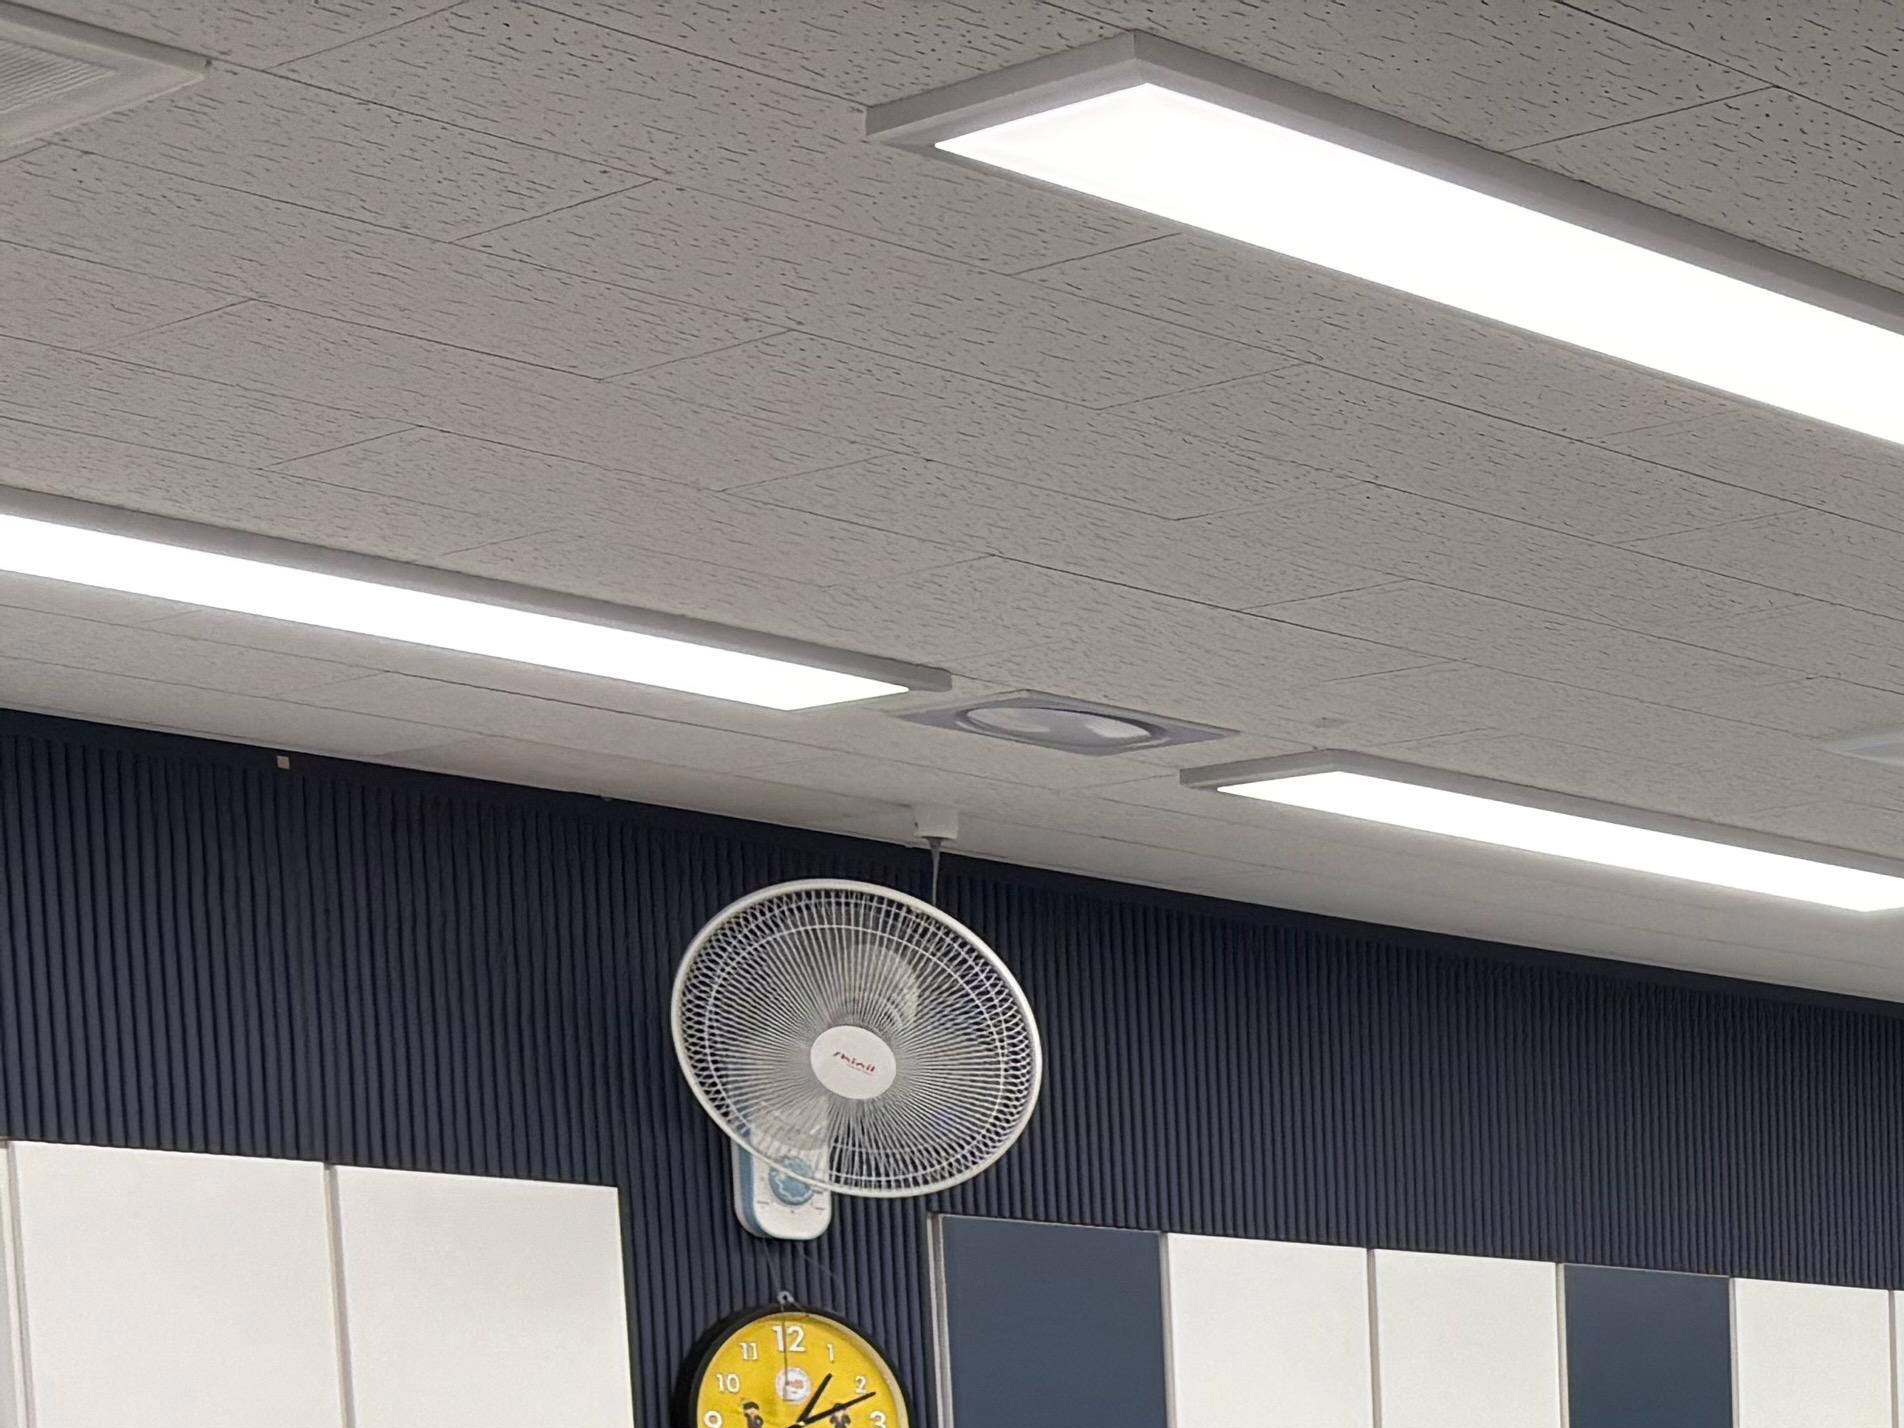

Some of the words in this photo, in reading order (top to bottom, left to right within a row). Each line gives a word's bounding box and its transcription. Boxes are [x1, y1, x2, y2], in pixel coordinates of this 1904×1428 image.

[772, 1325, 806, 1353] 12
[739, 1342, 758, 1361] 11
[827, 1343, 836, 1363] 1
[716, 1373, 740, 1393] 10
[855, 1375, 867, 1394] 2
